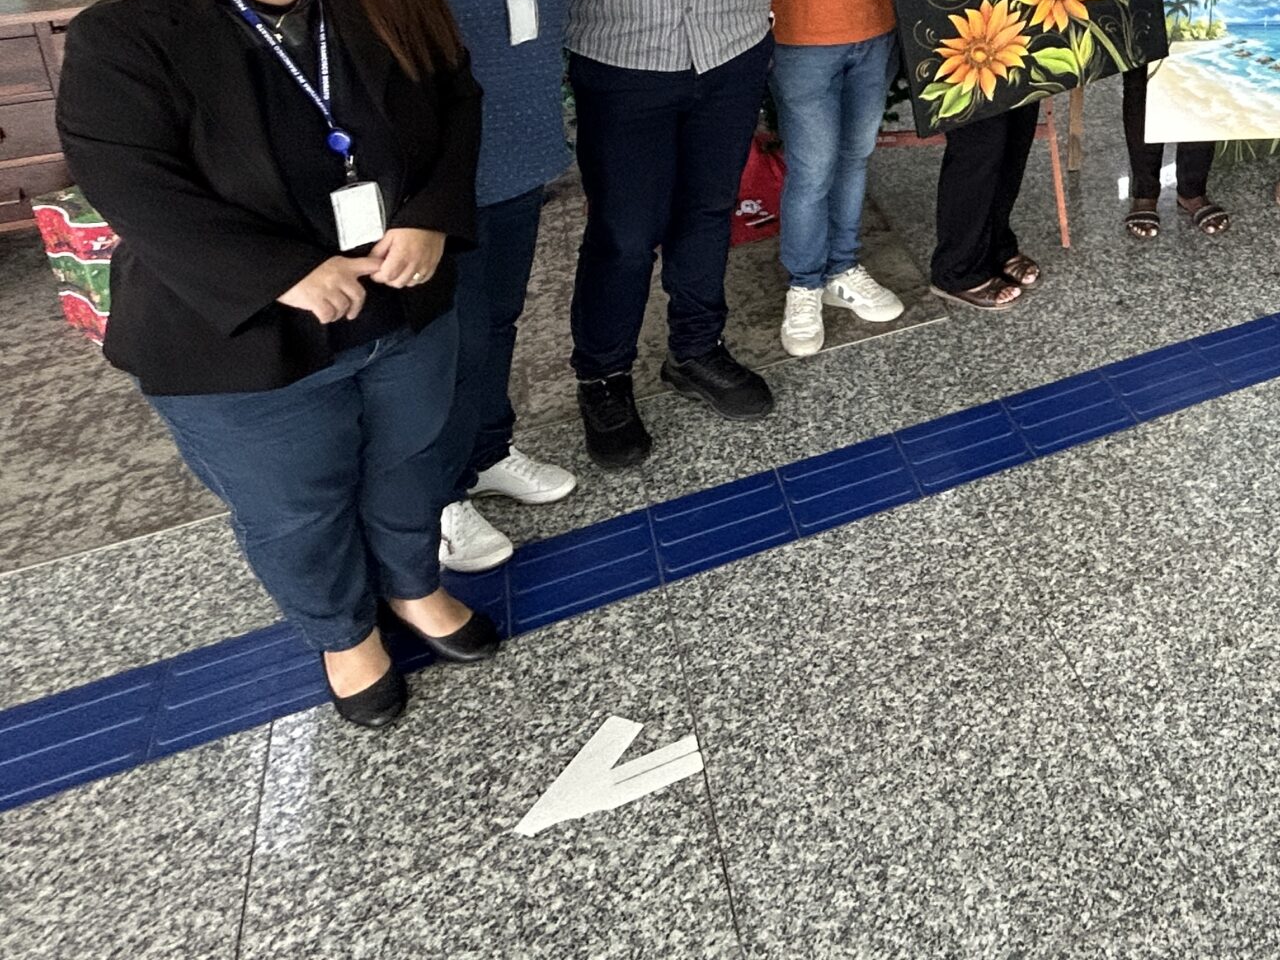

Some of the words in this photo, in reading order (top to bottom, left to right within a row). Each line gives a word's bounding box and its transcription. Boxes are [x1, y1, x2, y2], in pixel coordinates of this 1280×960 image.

[274, 45, 300, 76] FRANCISCO
[320, 41, 328, 75] FRANCISCO
[322, 75, 330, 101] MORATO
